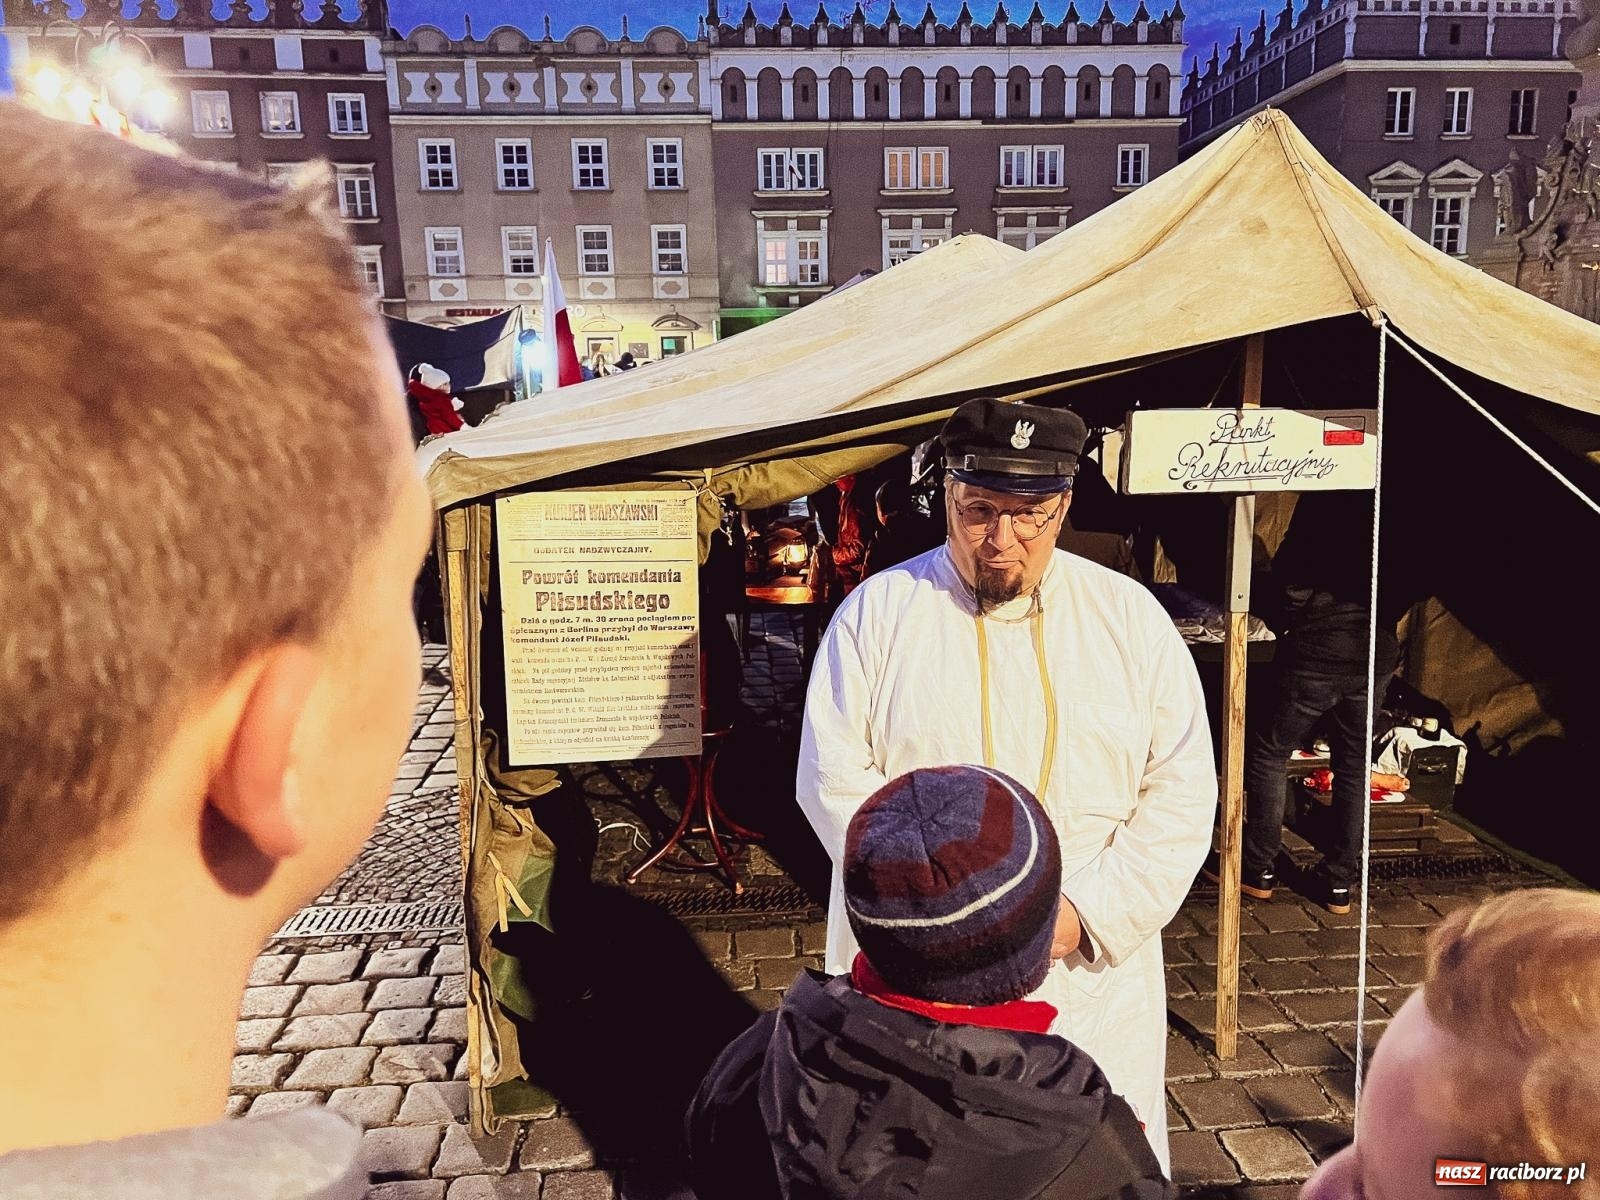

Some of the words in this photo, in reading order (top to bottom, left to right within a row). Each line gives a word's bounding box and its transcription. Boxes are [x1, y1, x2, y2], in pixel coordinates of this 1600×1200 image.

[1210, 412, 1274, 442] Punkt
[522, 569, 579, 585] Powrót
[587, 568, 682, 584] komendanta
[535, 590, 670, 612] Piłsudskiego
[561, 635, 584, 643] Józef
